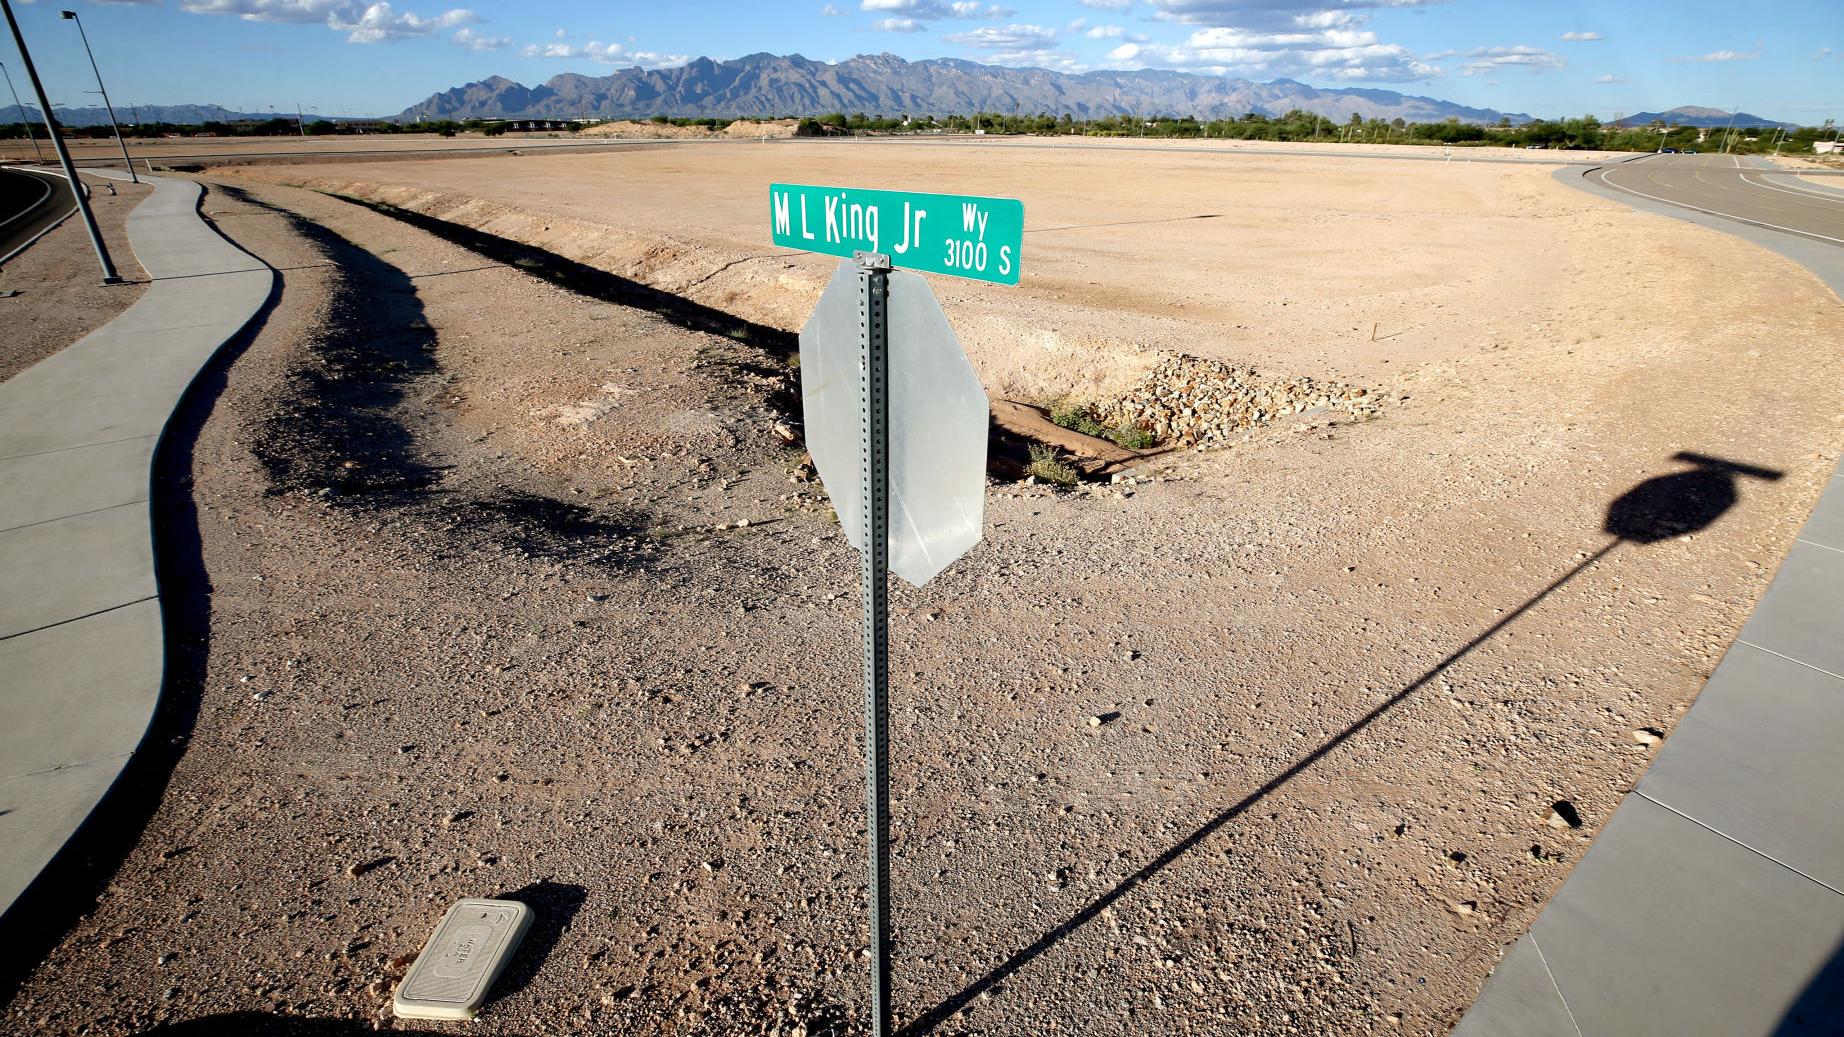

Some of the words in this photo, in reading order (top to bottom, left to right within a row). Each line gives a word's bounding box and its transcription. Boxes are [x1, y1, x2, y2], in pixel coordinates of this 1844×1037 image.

[774, 191, 790, 236] M
[801, 193, 815, 240] L
[824, 192, 879, 253] King
[894, 201, 927, 254] Jr
[962, 202, 989, 241] Wy
[943, 238, 988, 272] 3100
[999, 245, 1012, 275] S
